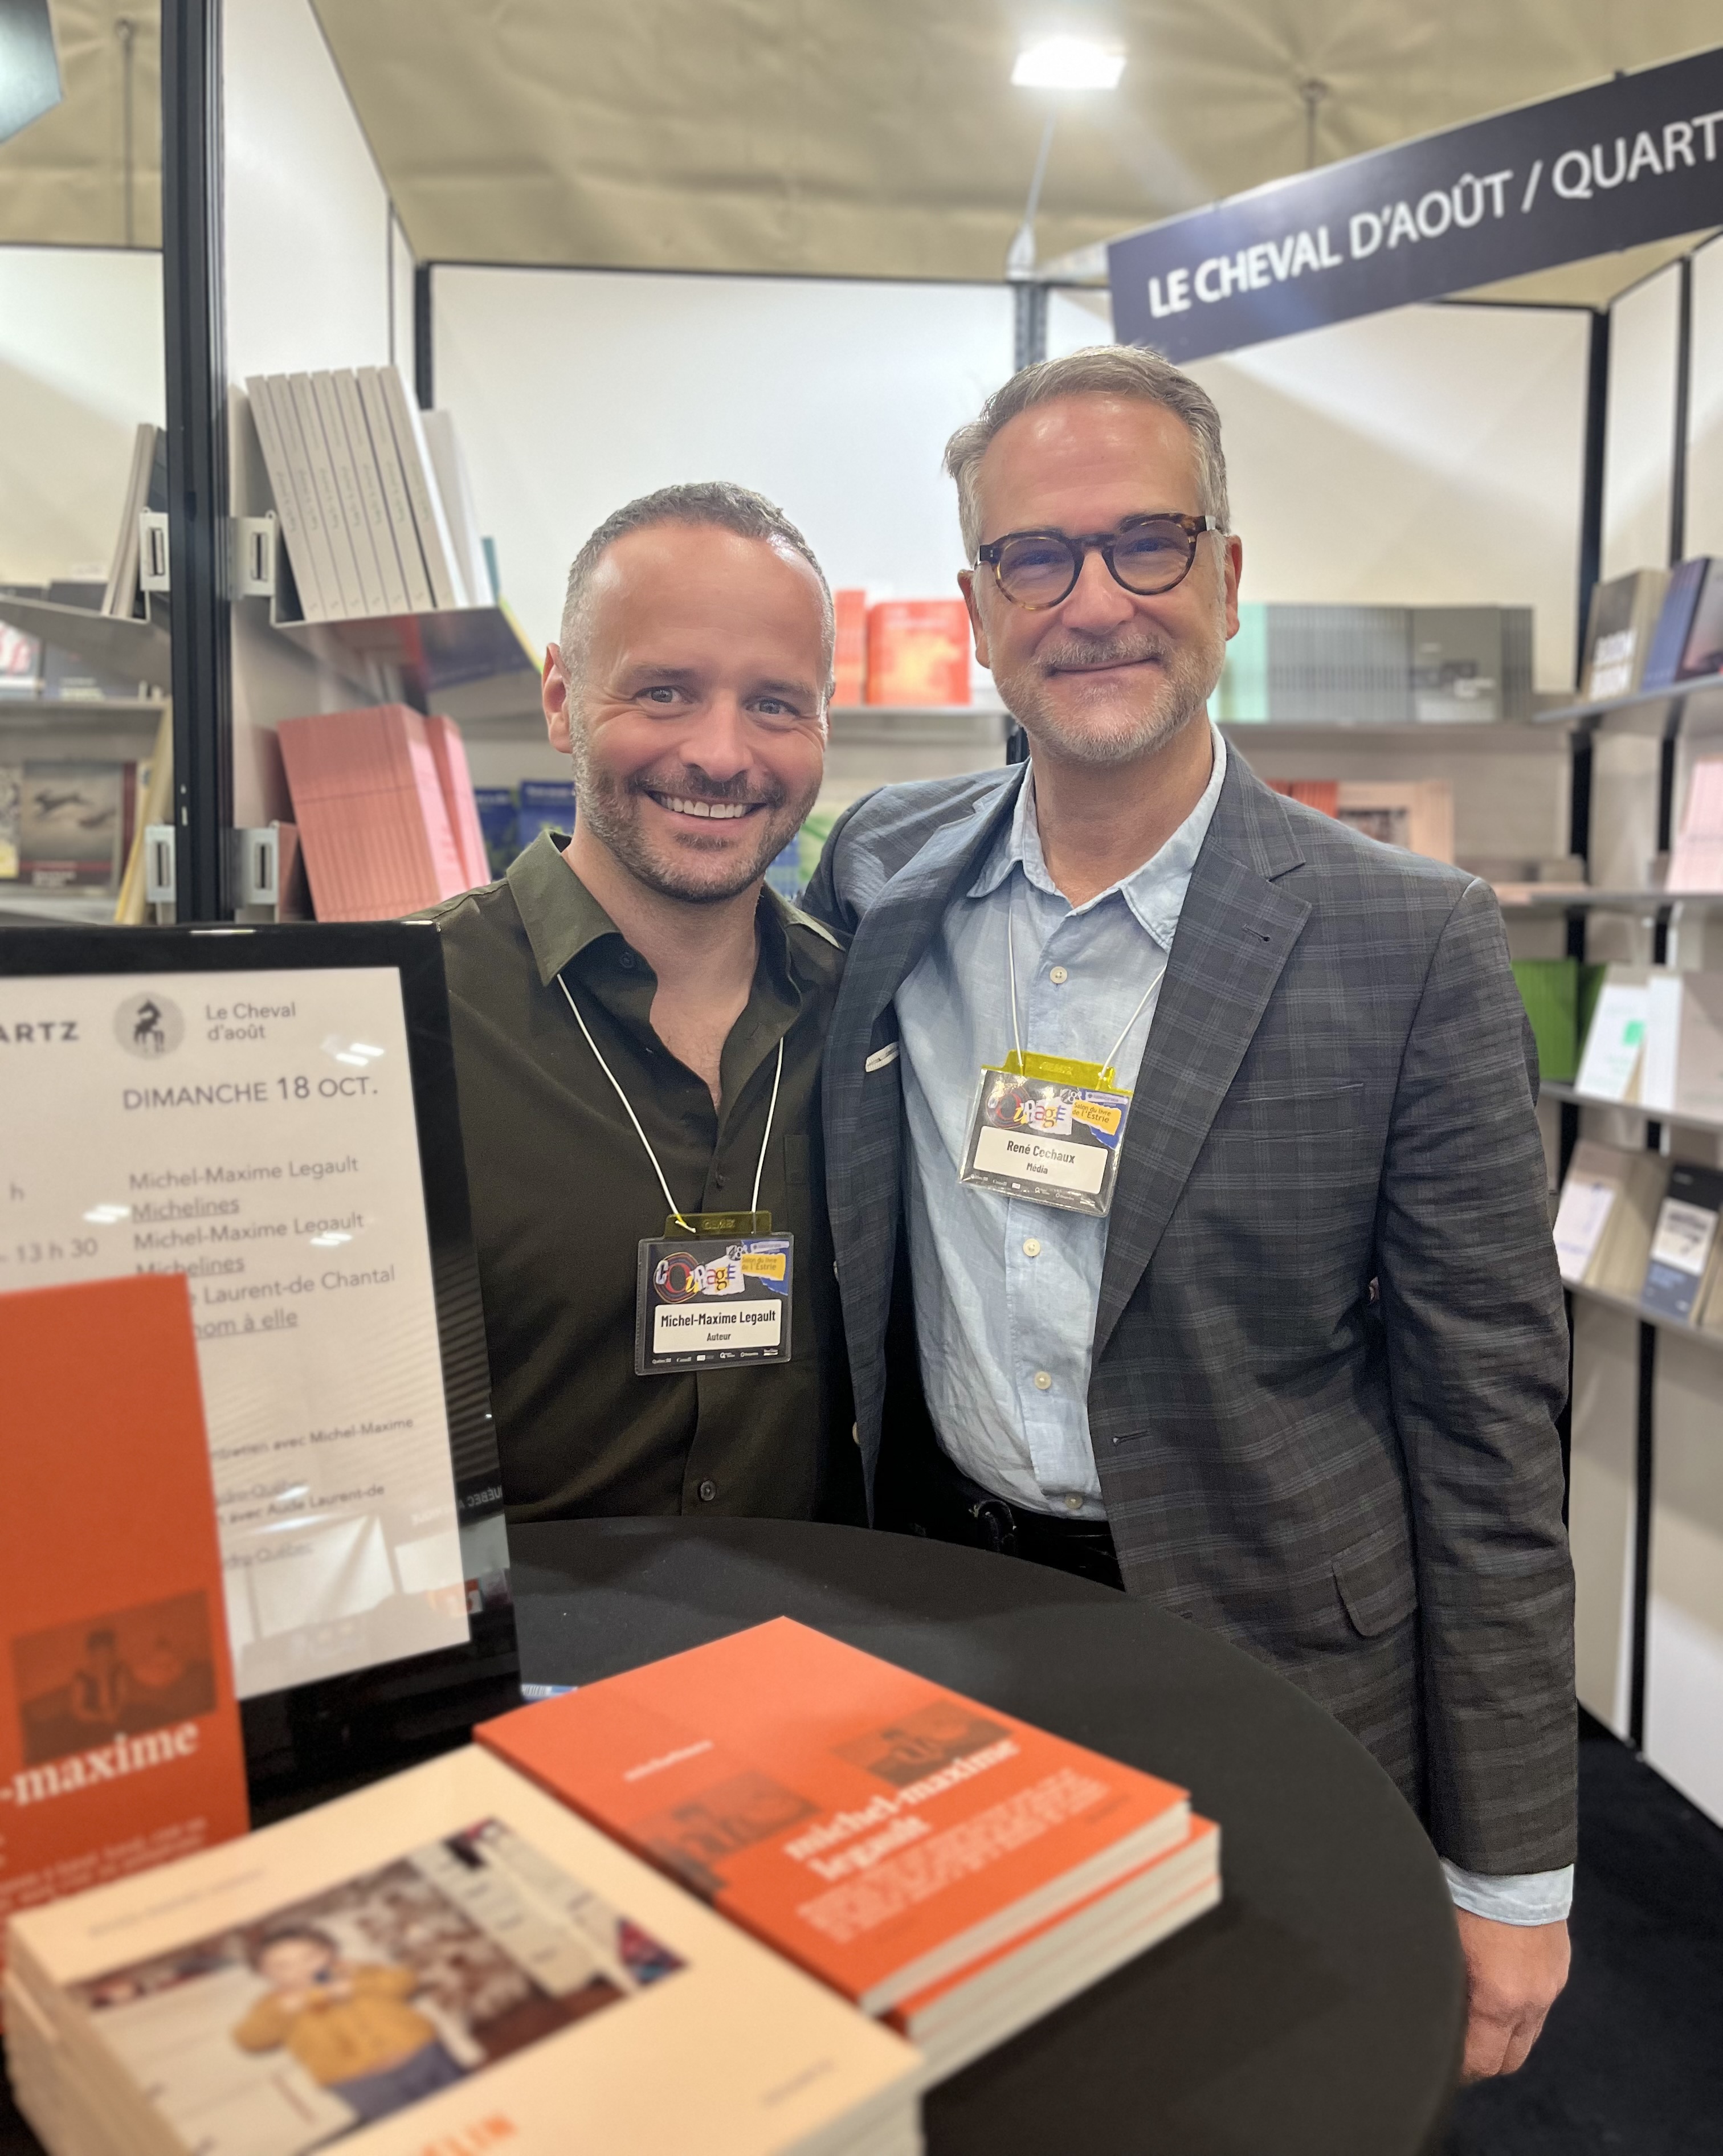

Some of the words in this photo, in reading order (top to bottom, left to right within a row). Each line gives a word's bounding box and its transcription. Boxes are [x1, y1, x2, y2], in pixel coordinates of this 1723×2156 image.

[1148, 267, 1192, 318] LE
[1194, 224, 1344, 303] CHEVAL
[1349, 169, 1514, 260] D'AOÛT
[1520, 158, 1544, 214] /
[1551, 109, 1723, 199] QUART
[206, 1004, 228, 1020] Le
[232, 1002, 296, 1019] Cheval
[207, 1024, 266, 1042] d'août
[123, 1083, 268, 1110] DIMANCHE
[276, 1076, 311, 1101] 18
[318, 1076, 378, 1098] OCT.
[1007, 1140, 1031, 1155] René
[129, 1166, 283, 1192] Michel-Maxime
[288, 1155, 360, 1179] Legault
[1026, 1162, 1048, 1174] Média
[130, 1197, 241, 1224] Michelines
[133, 1224, 288, 1252] Michel-Maxime
[294, 1212, 365, 1235] Legault
[203, 1277, 315, 1305] Laurent-de
[321, 1264, 396, 1291] Chantal
[243, 1313, 256, 1333] à
[261, 1308, 299, 1331] elle
[661, 1312, 737, 1328] Michel-Maxime
[740, 1310, 776, 1325] Legault
[707, 1333, 731, 1341] Auteur
